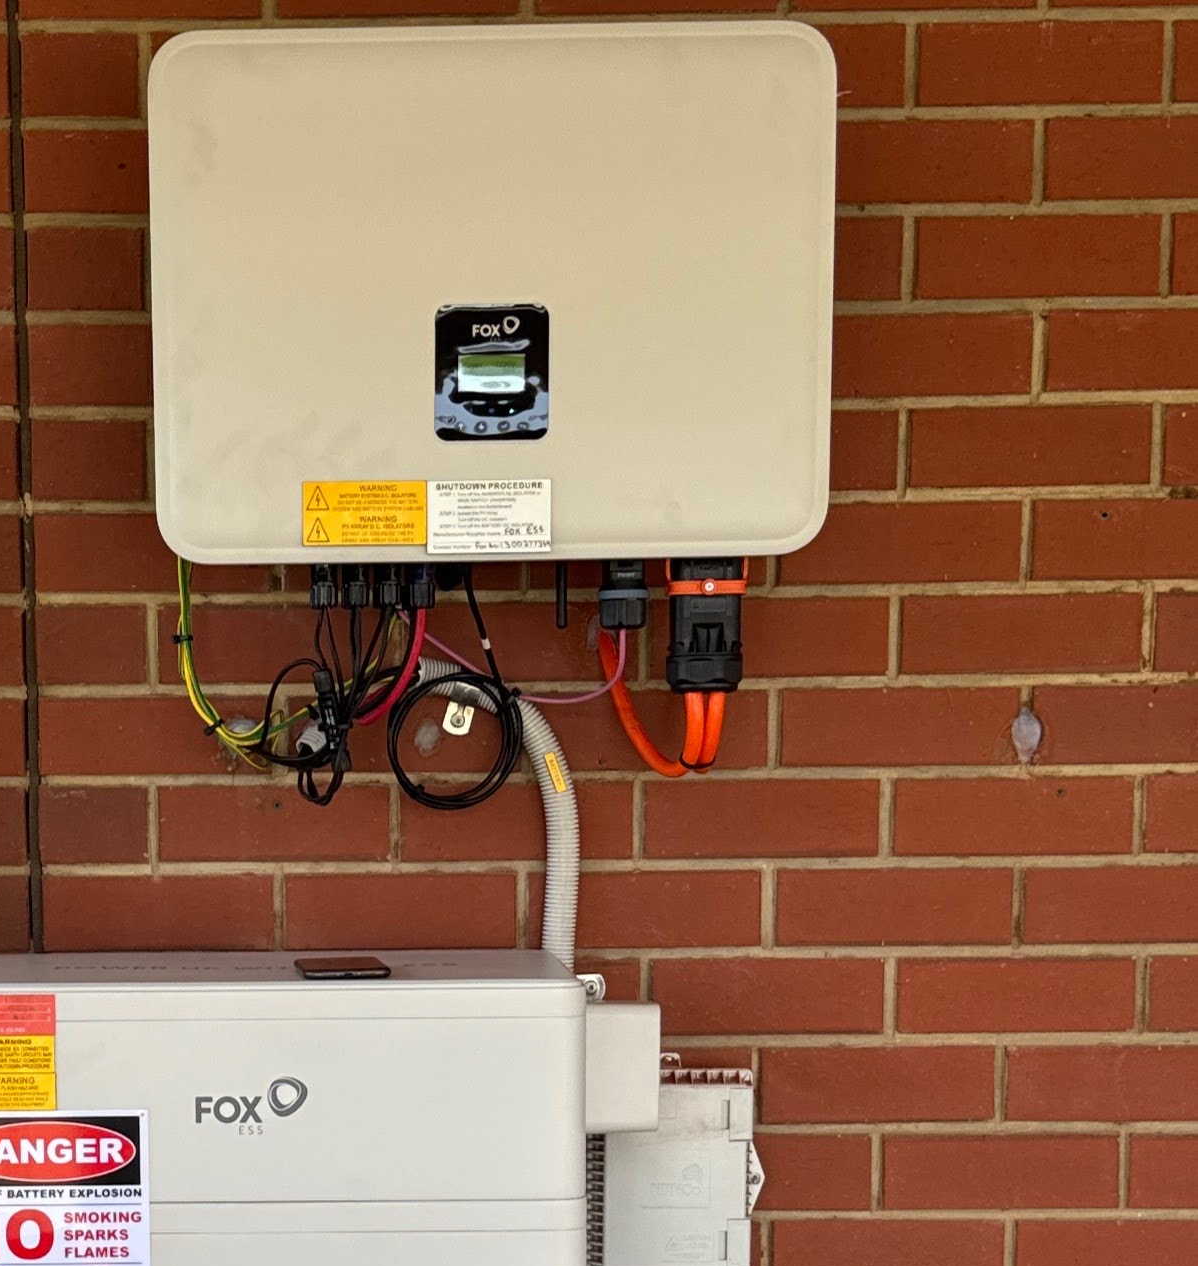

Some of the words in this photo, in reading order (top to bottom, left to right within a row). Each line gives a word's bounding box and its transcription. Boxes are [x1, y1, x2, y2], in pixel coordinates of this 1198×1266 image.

[472, 324, 501, 337] FOX
[359, 484, 397, 492] WARNING
[504, 527, 521, 536] FOX
[526, 525, 544, 535] ESS
[195, 1096, 262, 1123] FOX
[239, 1125, 263, 1135] ESS
[7, 1189, 64, 1198] BATTERY
[69, 1188, 142, 1198] EXPLOSION
[64, 1211, 142, 1224] SMOKING
[64, 1229, 129, 1241] SPARKS
[64, 1246, 130, 1258] FLAMES
